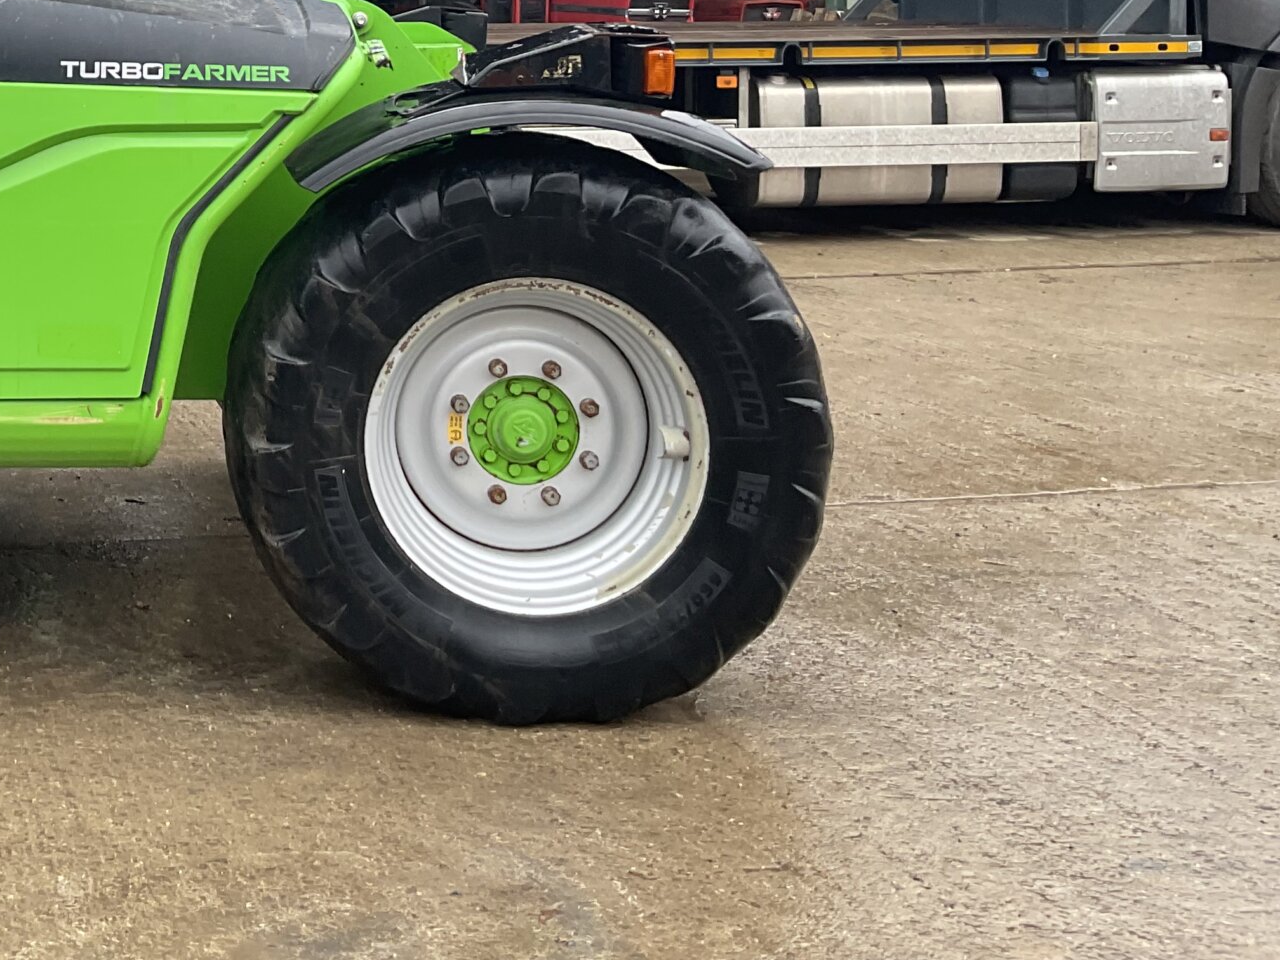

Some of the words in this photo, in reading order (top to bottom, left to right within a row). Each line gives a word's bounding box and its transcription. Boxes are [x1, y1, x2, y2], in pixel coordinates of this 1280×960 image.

[60, 60, 291, 83] TURBOFARMER
[1105, 131, 1176, 144] VOLVO
[316, 473, 412, 620] MICHELIN
